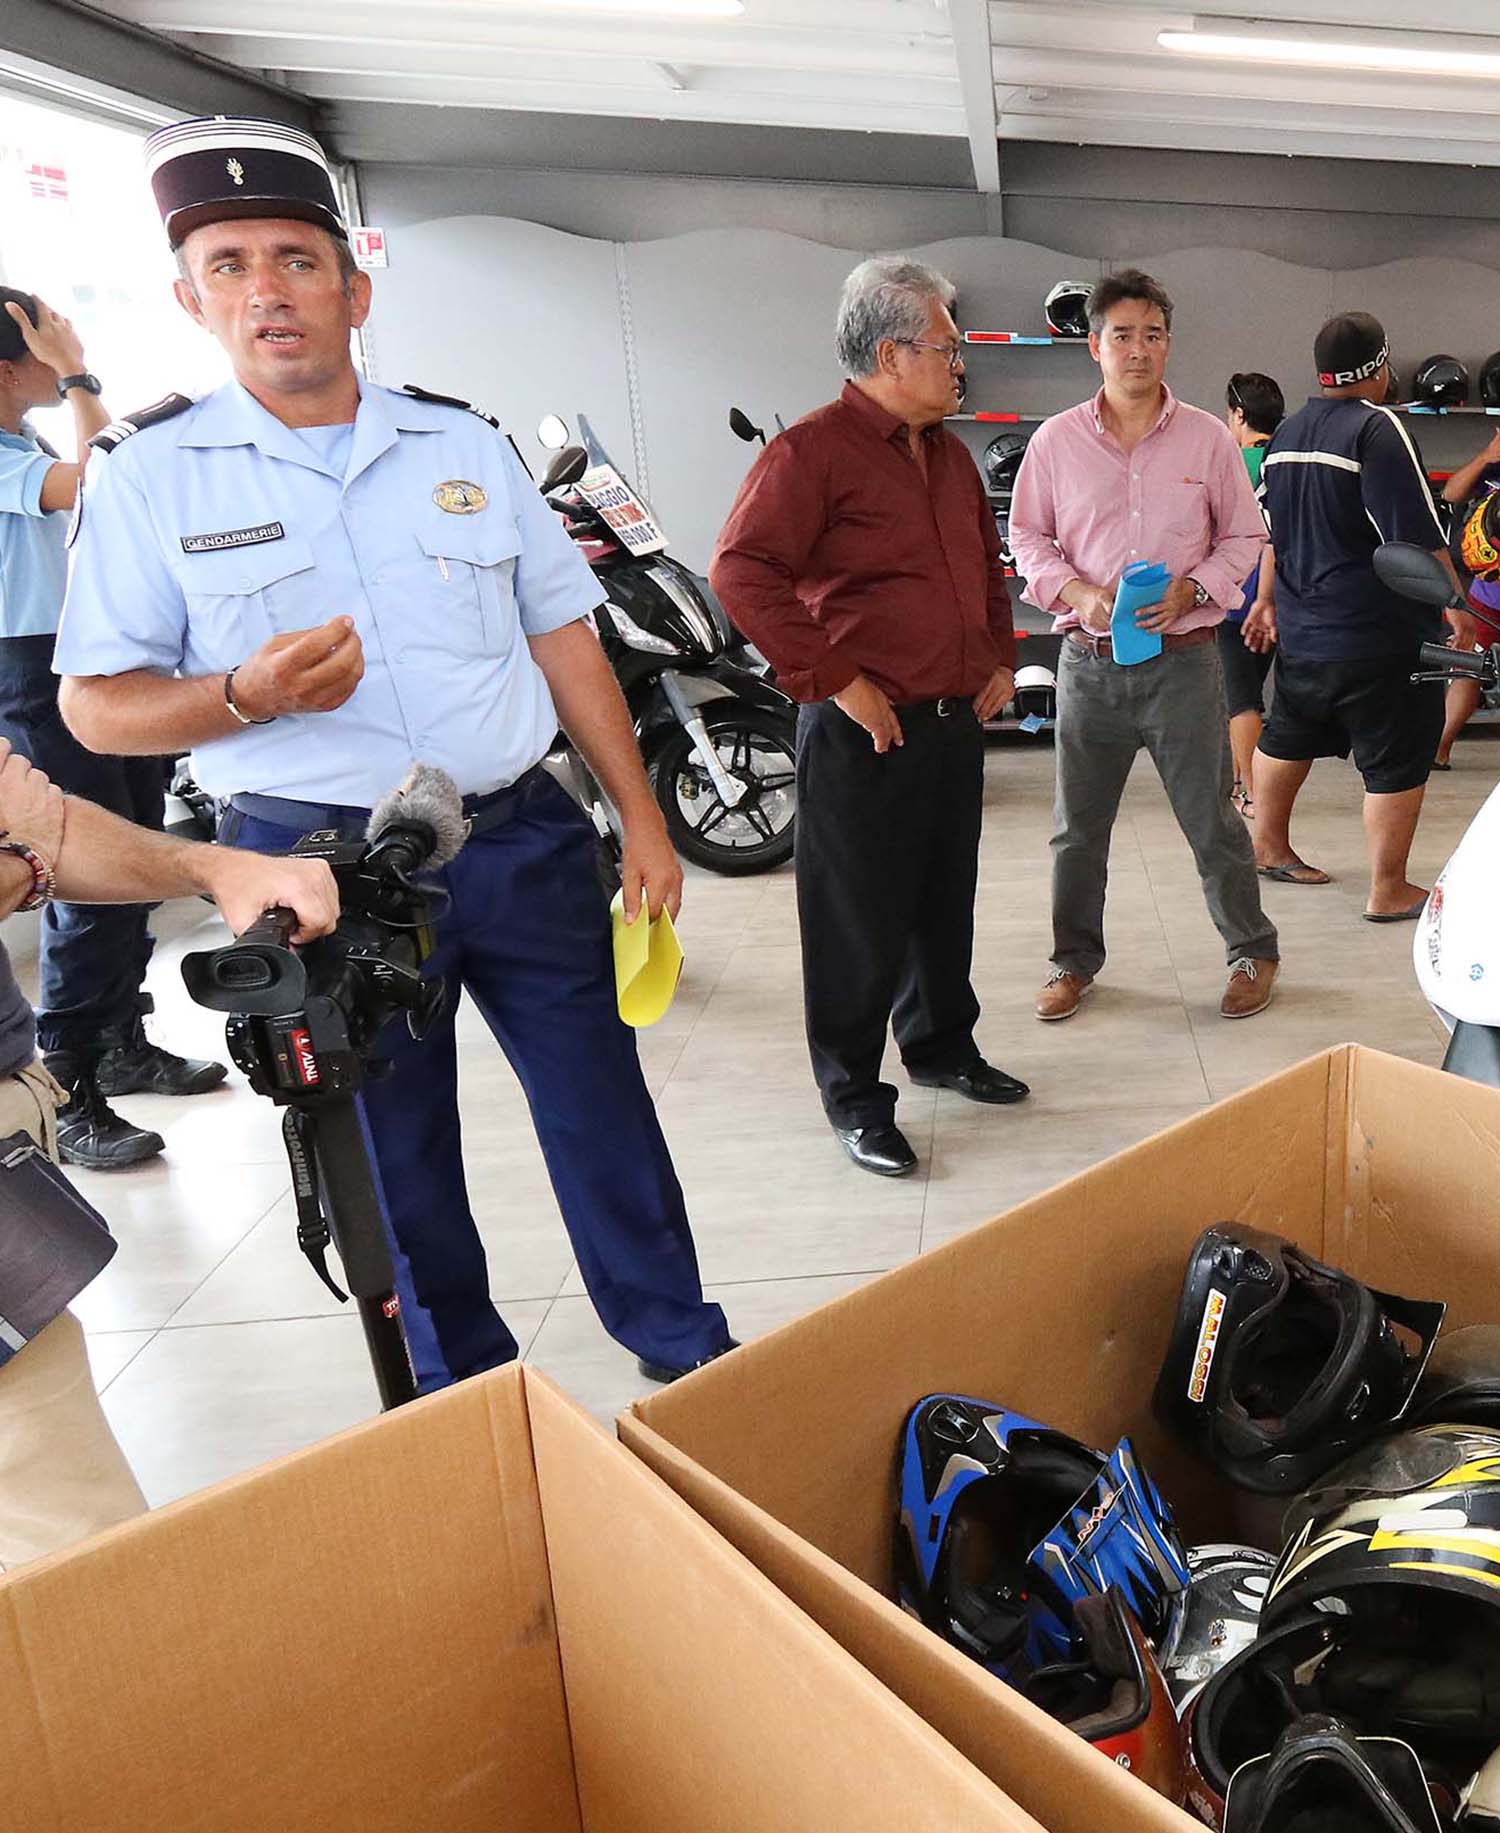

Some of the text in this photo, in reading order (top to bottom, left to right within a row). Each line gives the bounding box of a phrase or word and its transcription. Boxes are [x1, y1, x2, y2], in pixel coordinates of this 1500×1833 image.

[186, 525, 281, 549] GENDARMERIE
[300, 1050, 319, 1082] TNTV
[284, 1113, 313, 1198] Manfrotto
[1190, 1294, 1224, 1400] MALOSSI
